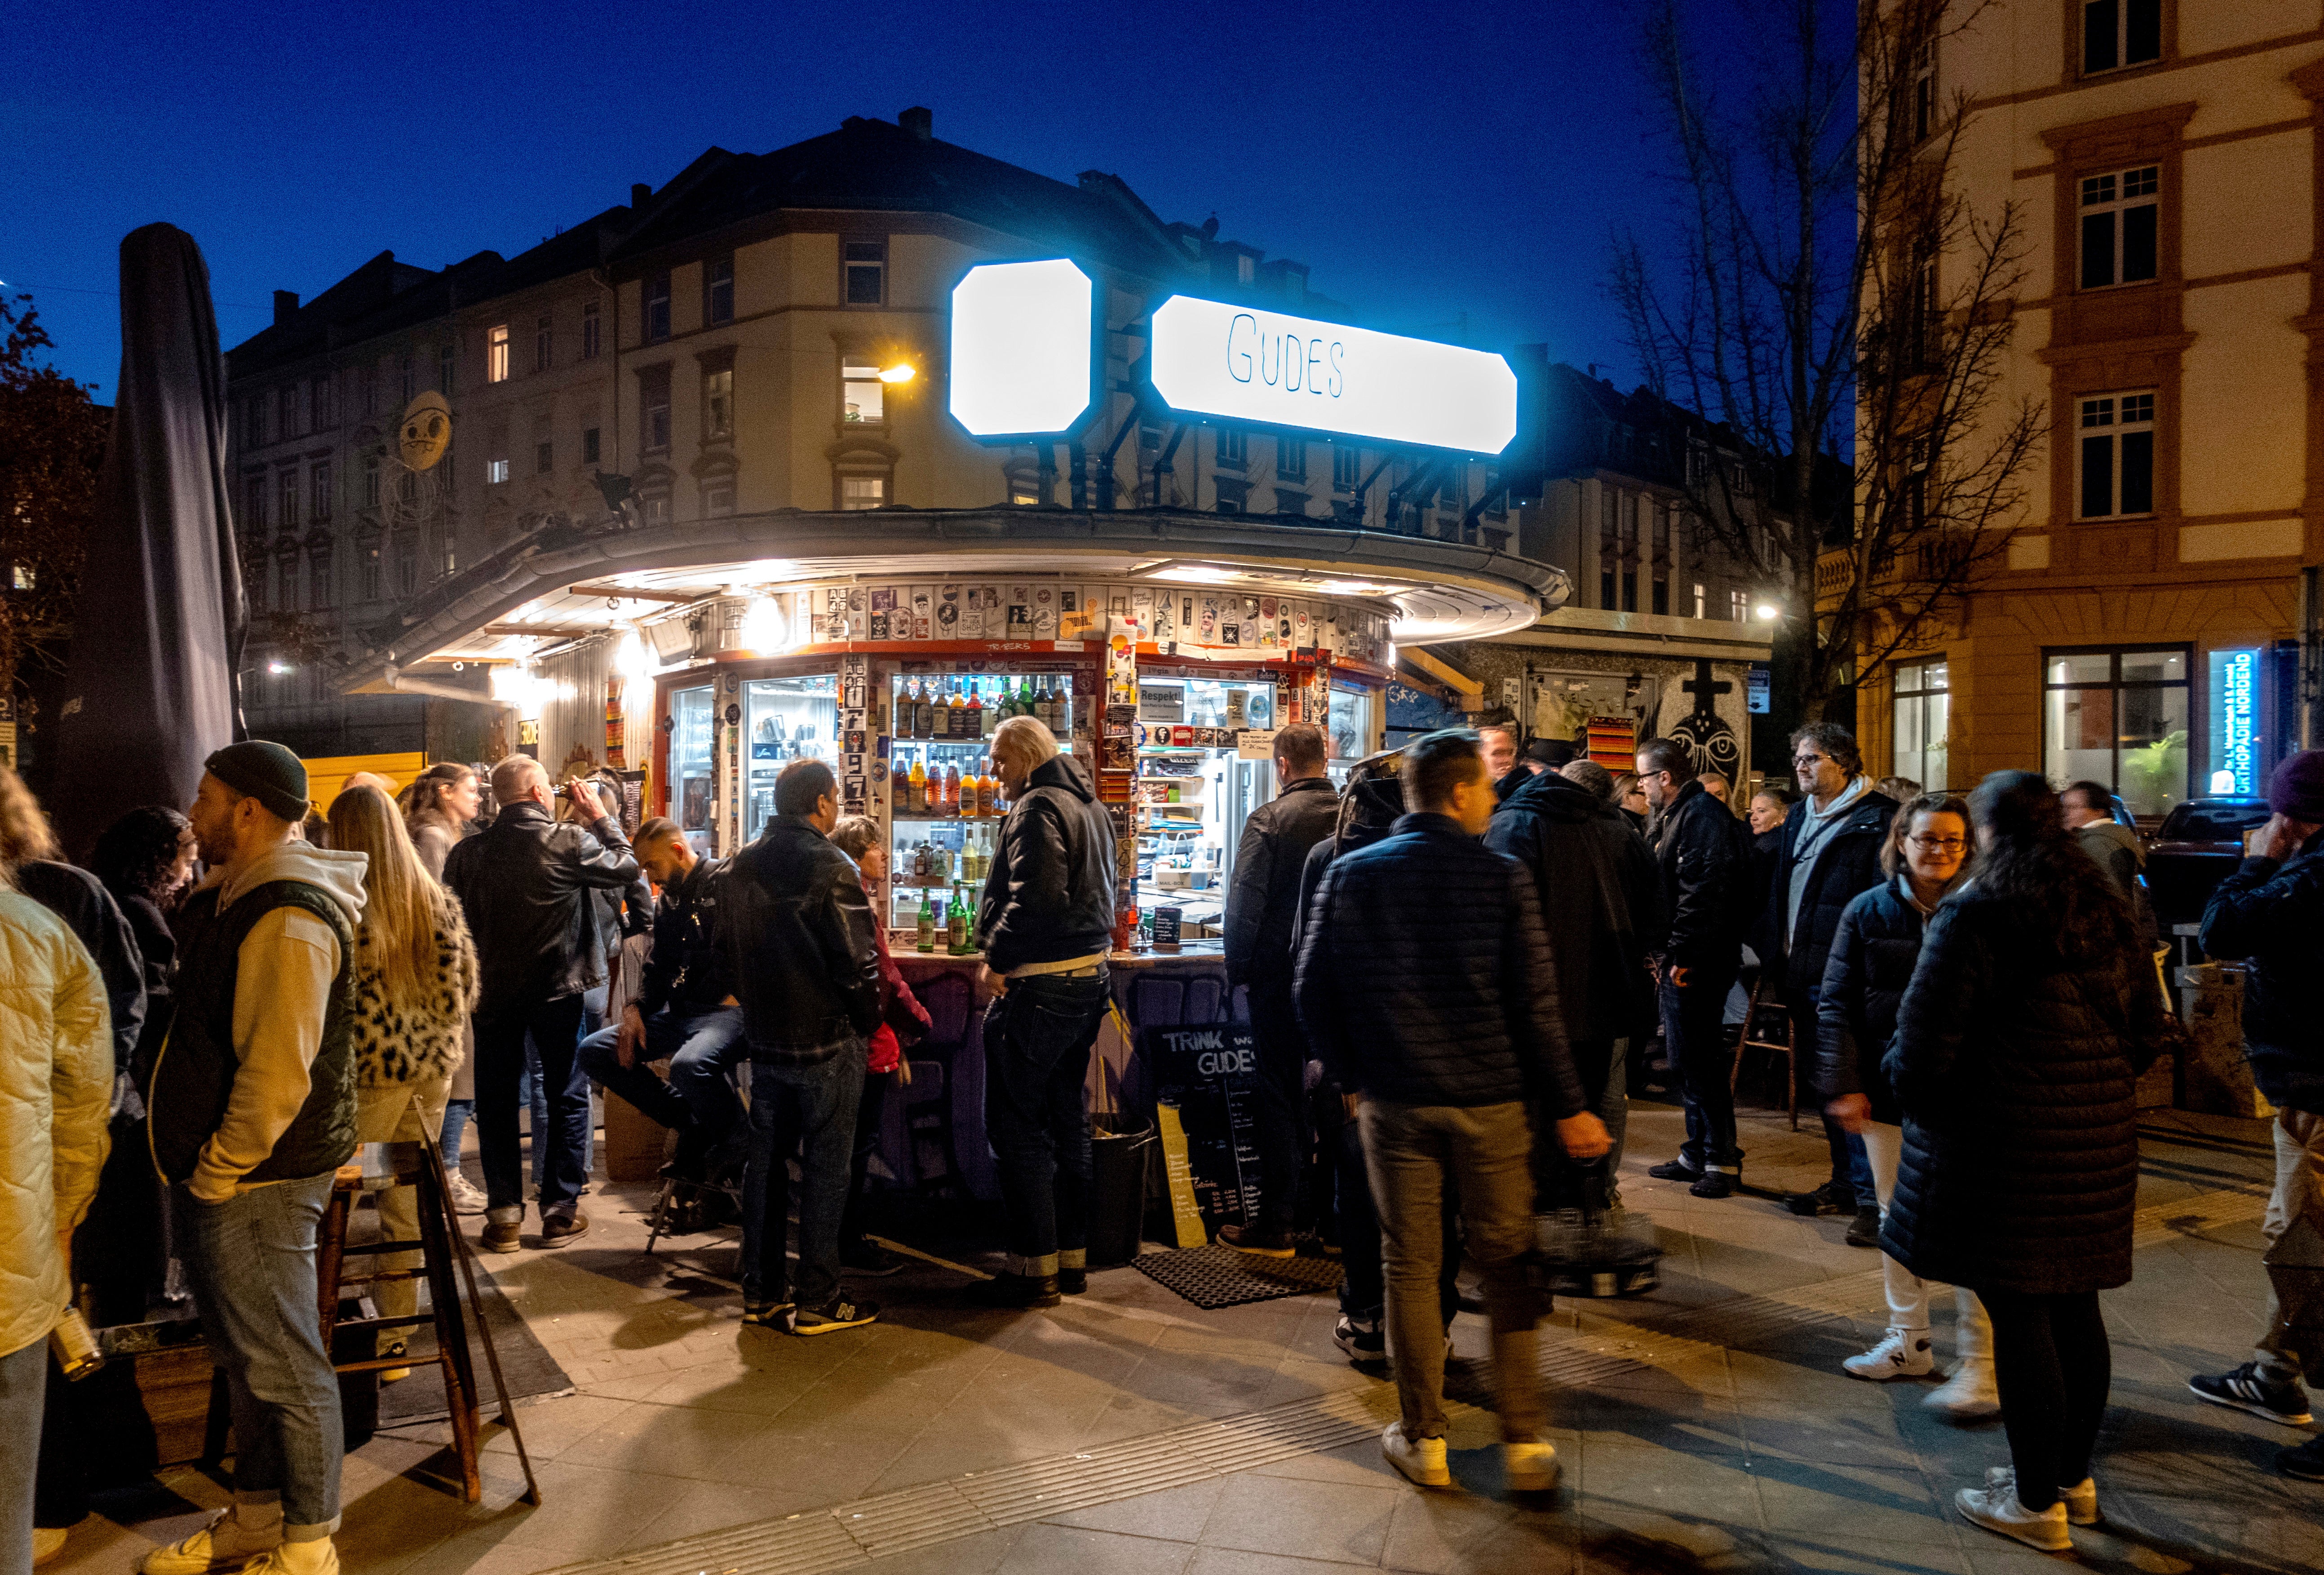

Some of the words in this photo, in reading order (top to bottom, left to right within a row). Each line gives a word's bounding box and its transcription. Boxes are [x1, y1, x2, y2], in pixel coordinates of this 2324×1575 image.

[1227, 314, 1343, 398] GUDES
[2235, 654, 2252, 714] NORDEND
[1142, 690, 1181, 702] Respekt!
[1162, 1030, 1224, 1052] TRINK
[836, 1302, 855, 1321] N
